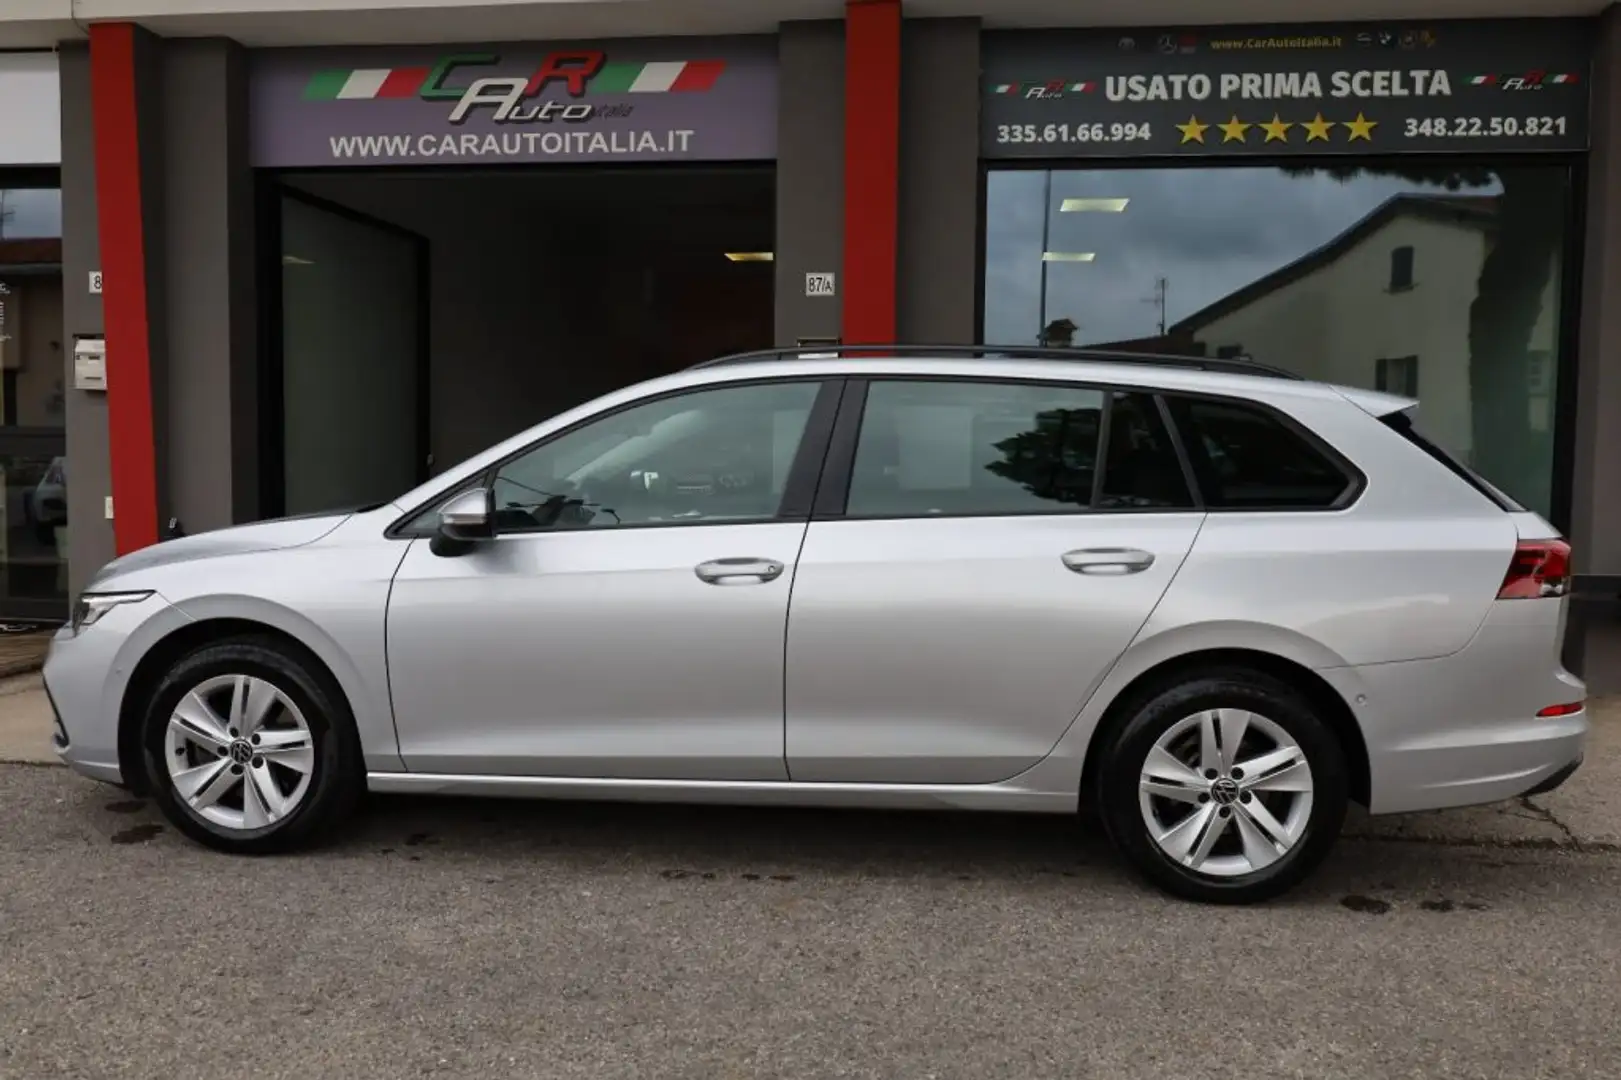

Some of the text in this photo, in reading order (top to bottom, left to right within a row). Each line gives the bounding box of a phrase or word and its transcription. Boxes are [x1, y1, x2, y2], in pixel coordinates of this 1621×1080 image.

[1105, 69, 1452, 102] USATO PRIMA SCELTA
[996, 122, 1152, 143] 335.61.66.994
[1403, 116, 1568, 138] 348.22.50.821
[329, 129, 694, 160] WWW.CARAUTOITALIA.IT
[808, 276, 833, 293] 87/A
